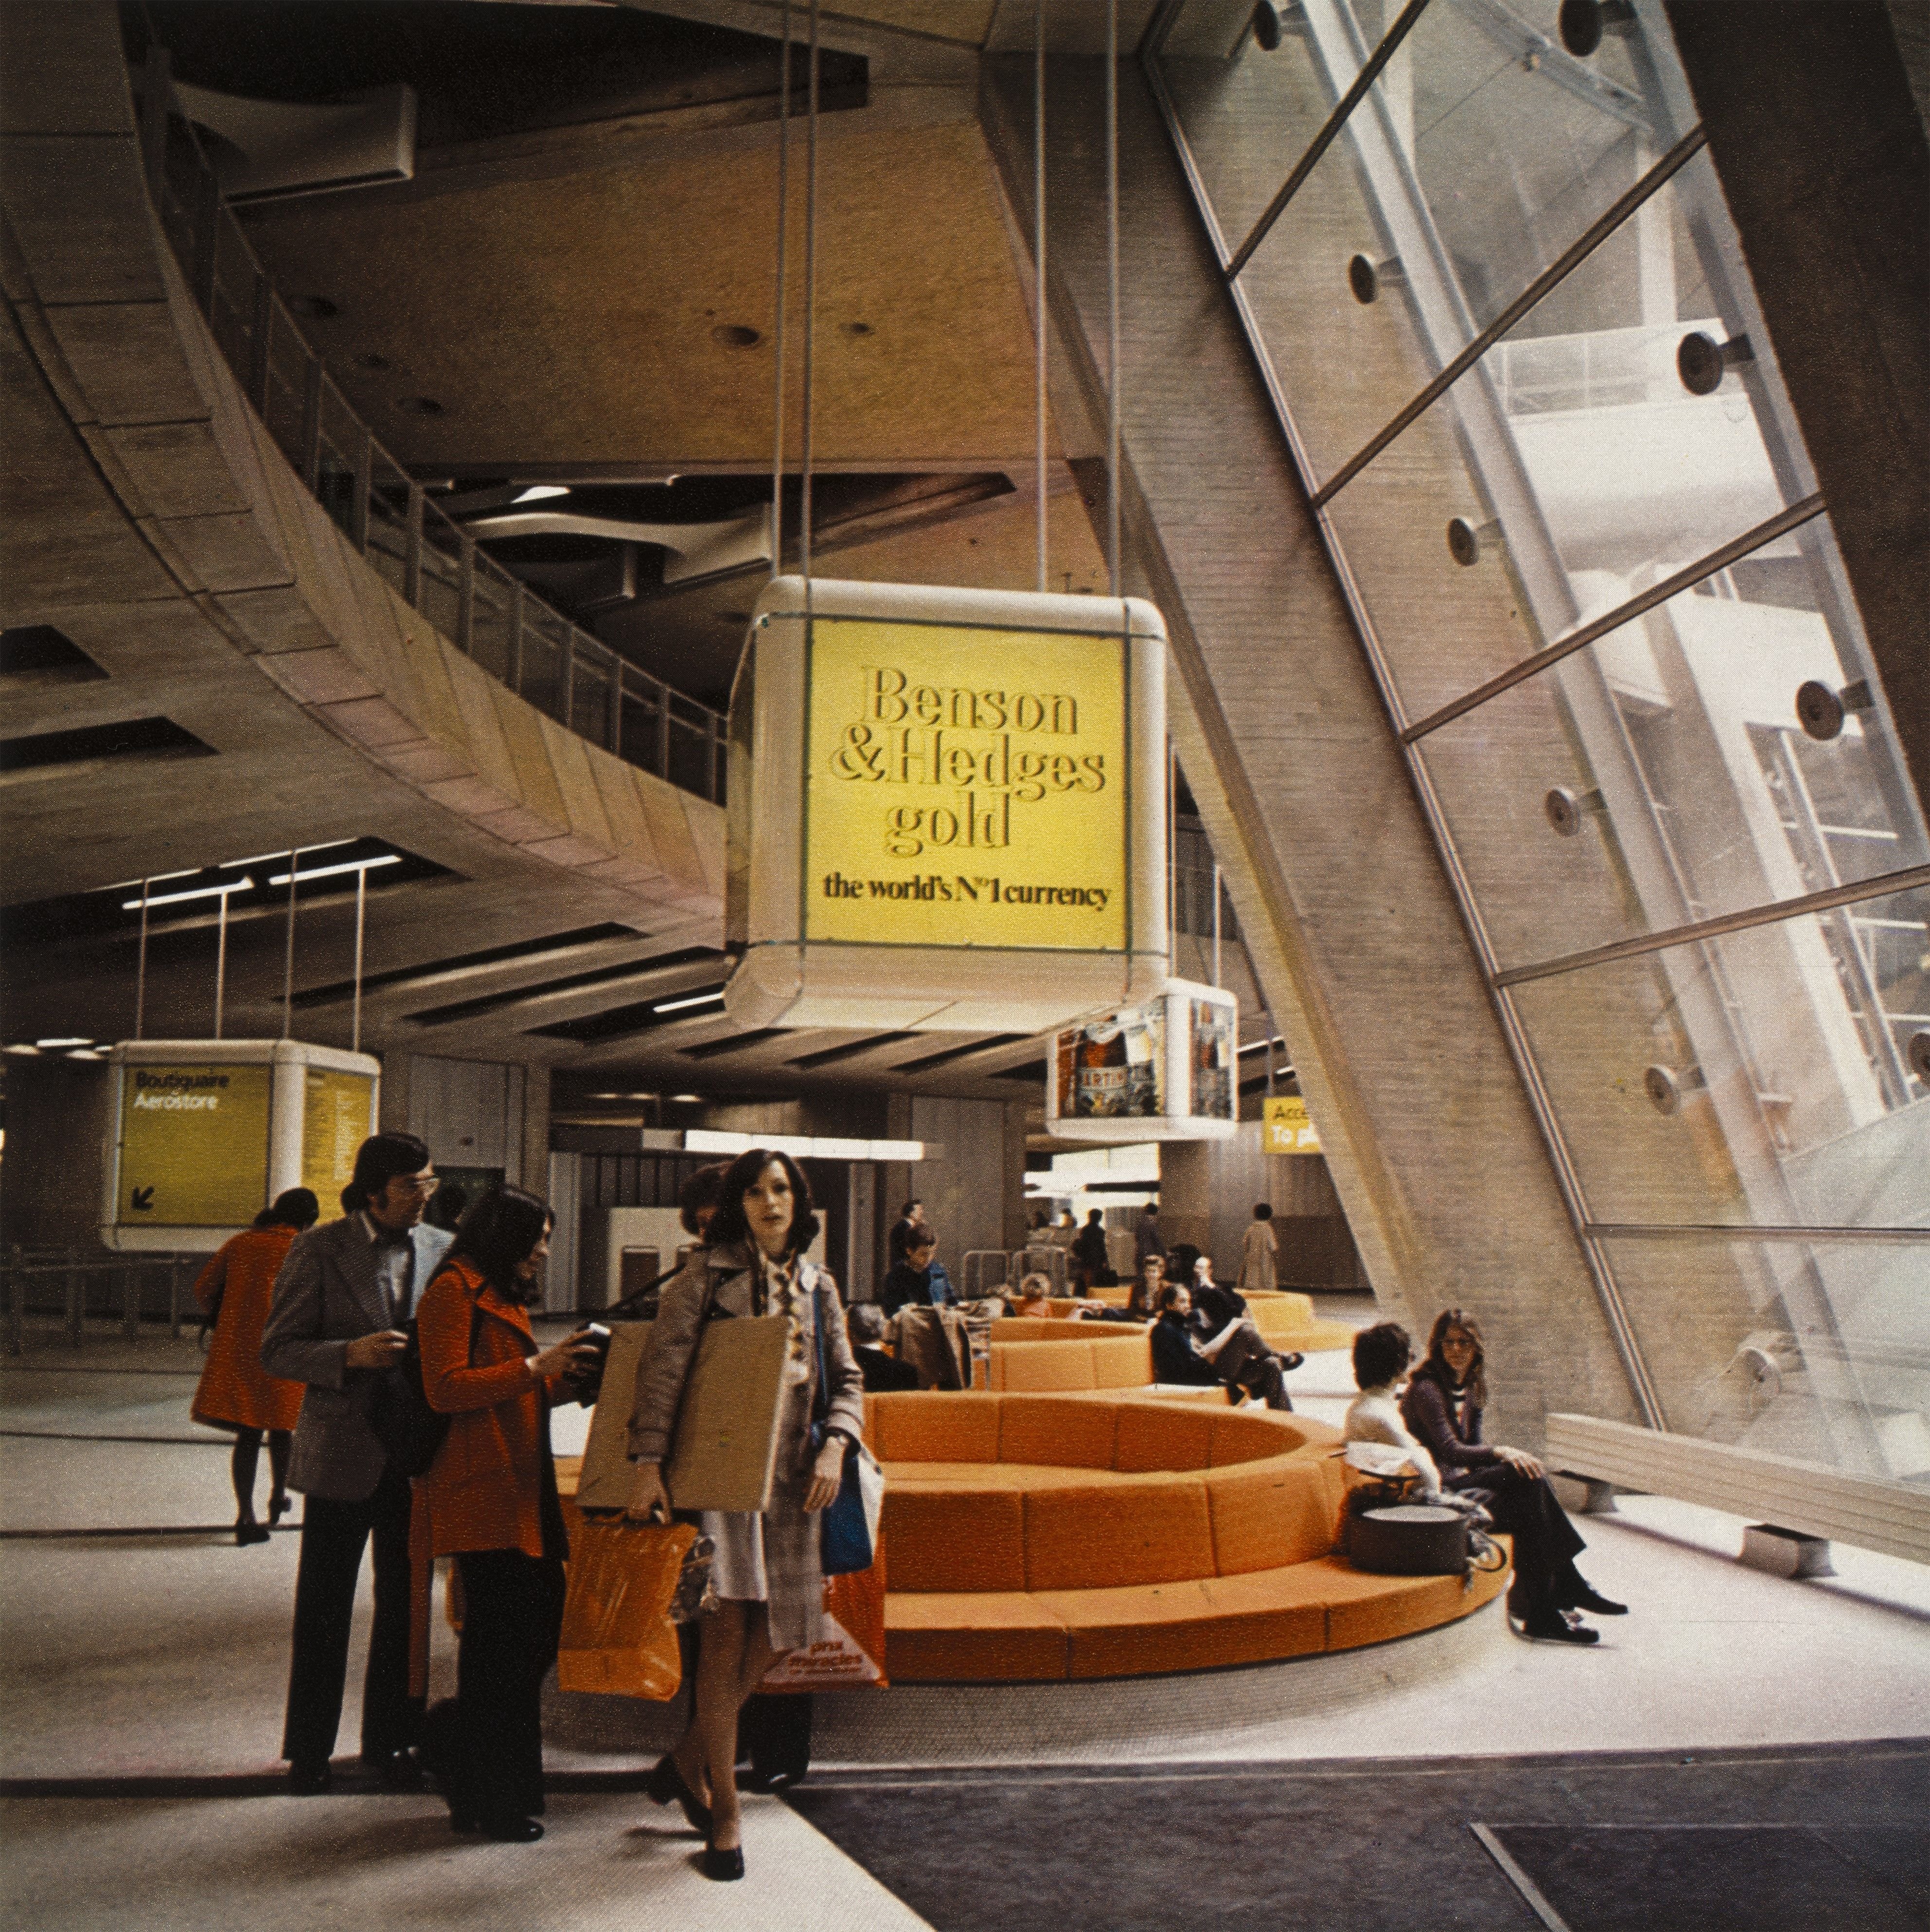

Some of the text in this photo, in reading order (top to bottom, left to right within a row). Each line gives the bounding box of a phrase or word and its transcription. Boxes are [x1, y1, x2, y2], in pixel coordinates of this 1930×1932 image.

[860, 664, 1077, 734] Benson
[884, 789, 1010, 858] gold
[823, 872, 863, 898] the
[868, 875, 952, 902] world's
[1003, 884, 1111, 912] currency
[1271, 1125, 1292, 1145] To
